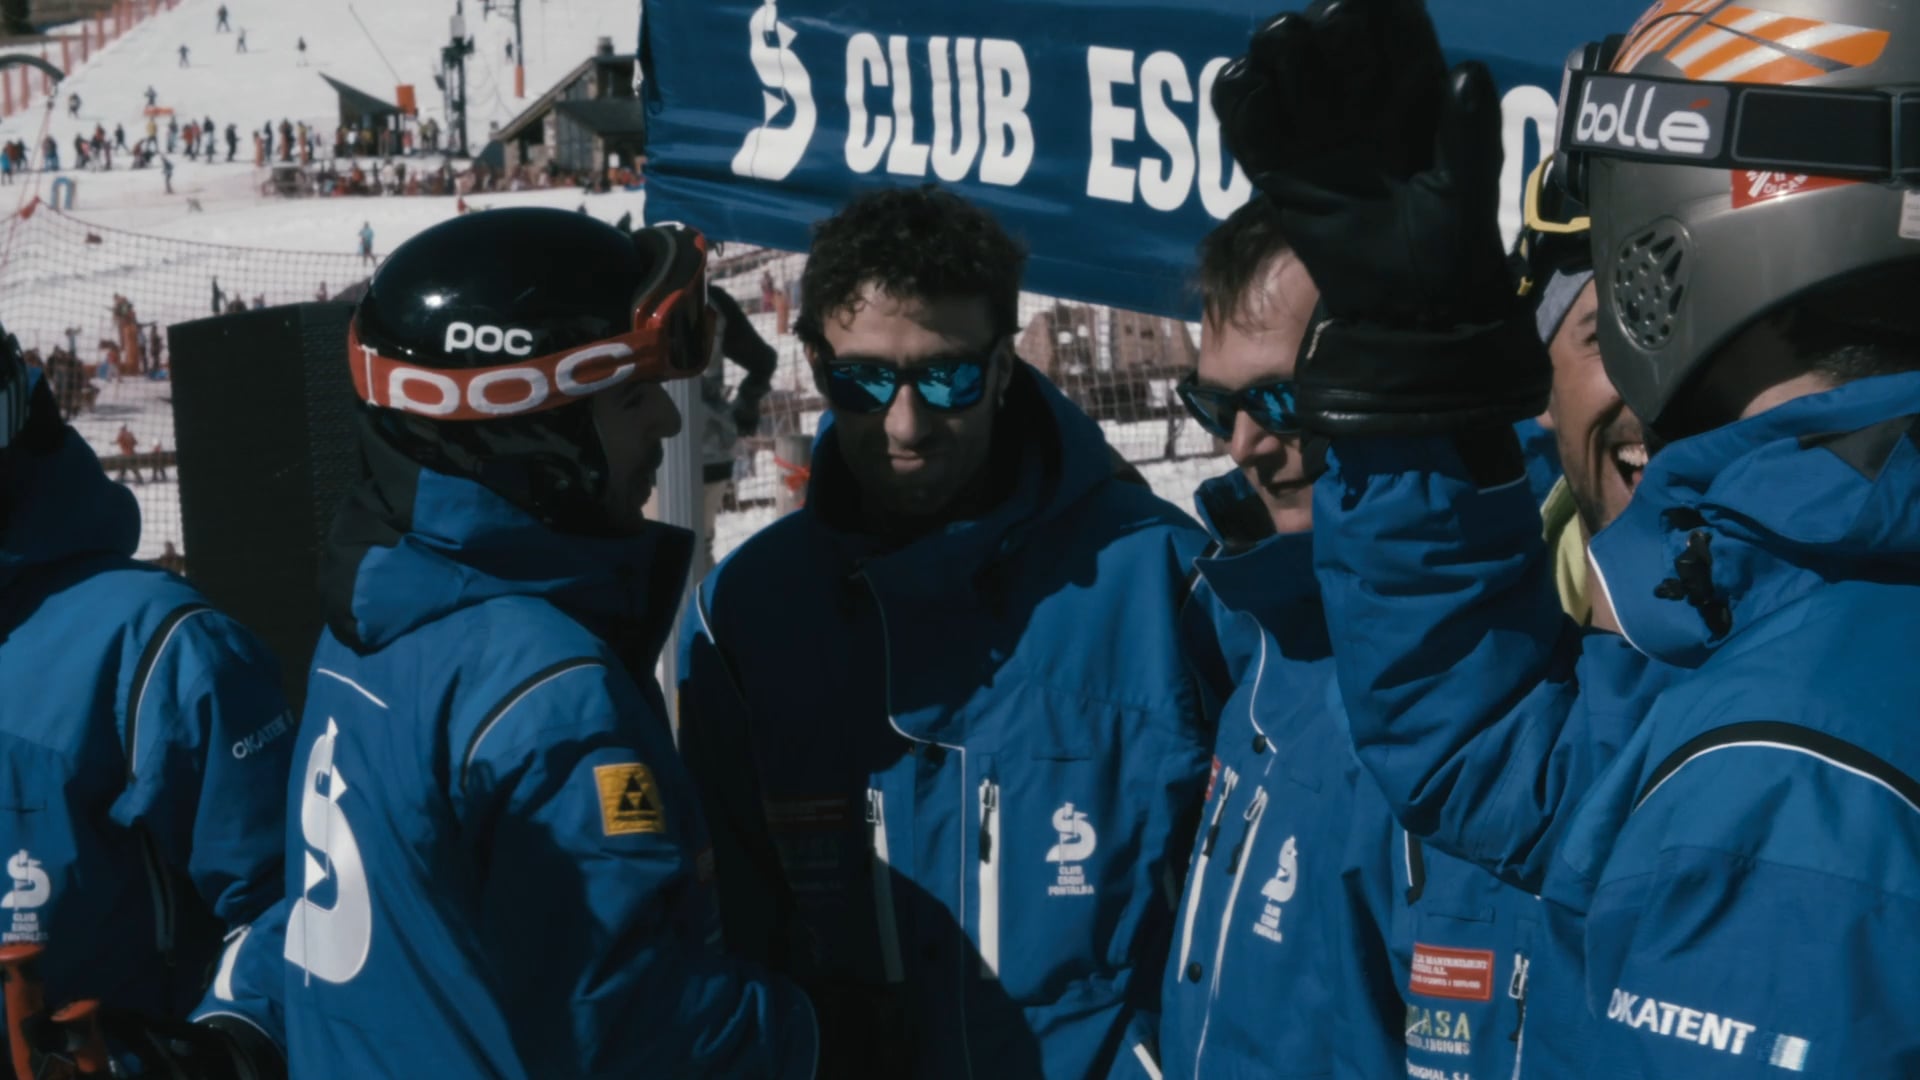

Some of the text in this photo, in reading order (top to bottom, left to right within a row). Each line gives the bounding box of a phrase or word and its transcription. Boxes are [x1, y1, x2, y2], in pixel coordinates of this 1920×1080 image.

[845, 32, 1035, 187] CLUB
[1575, 81, 1711, 154] bollé
[1607, 988, 1756, 1055] OKATENT
